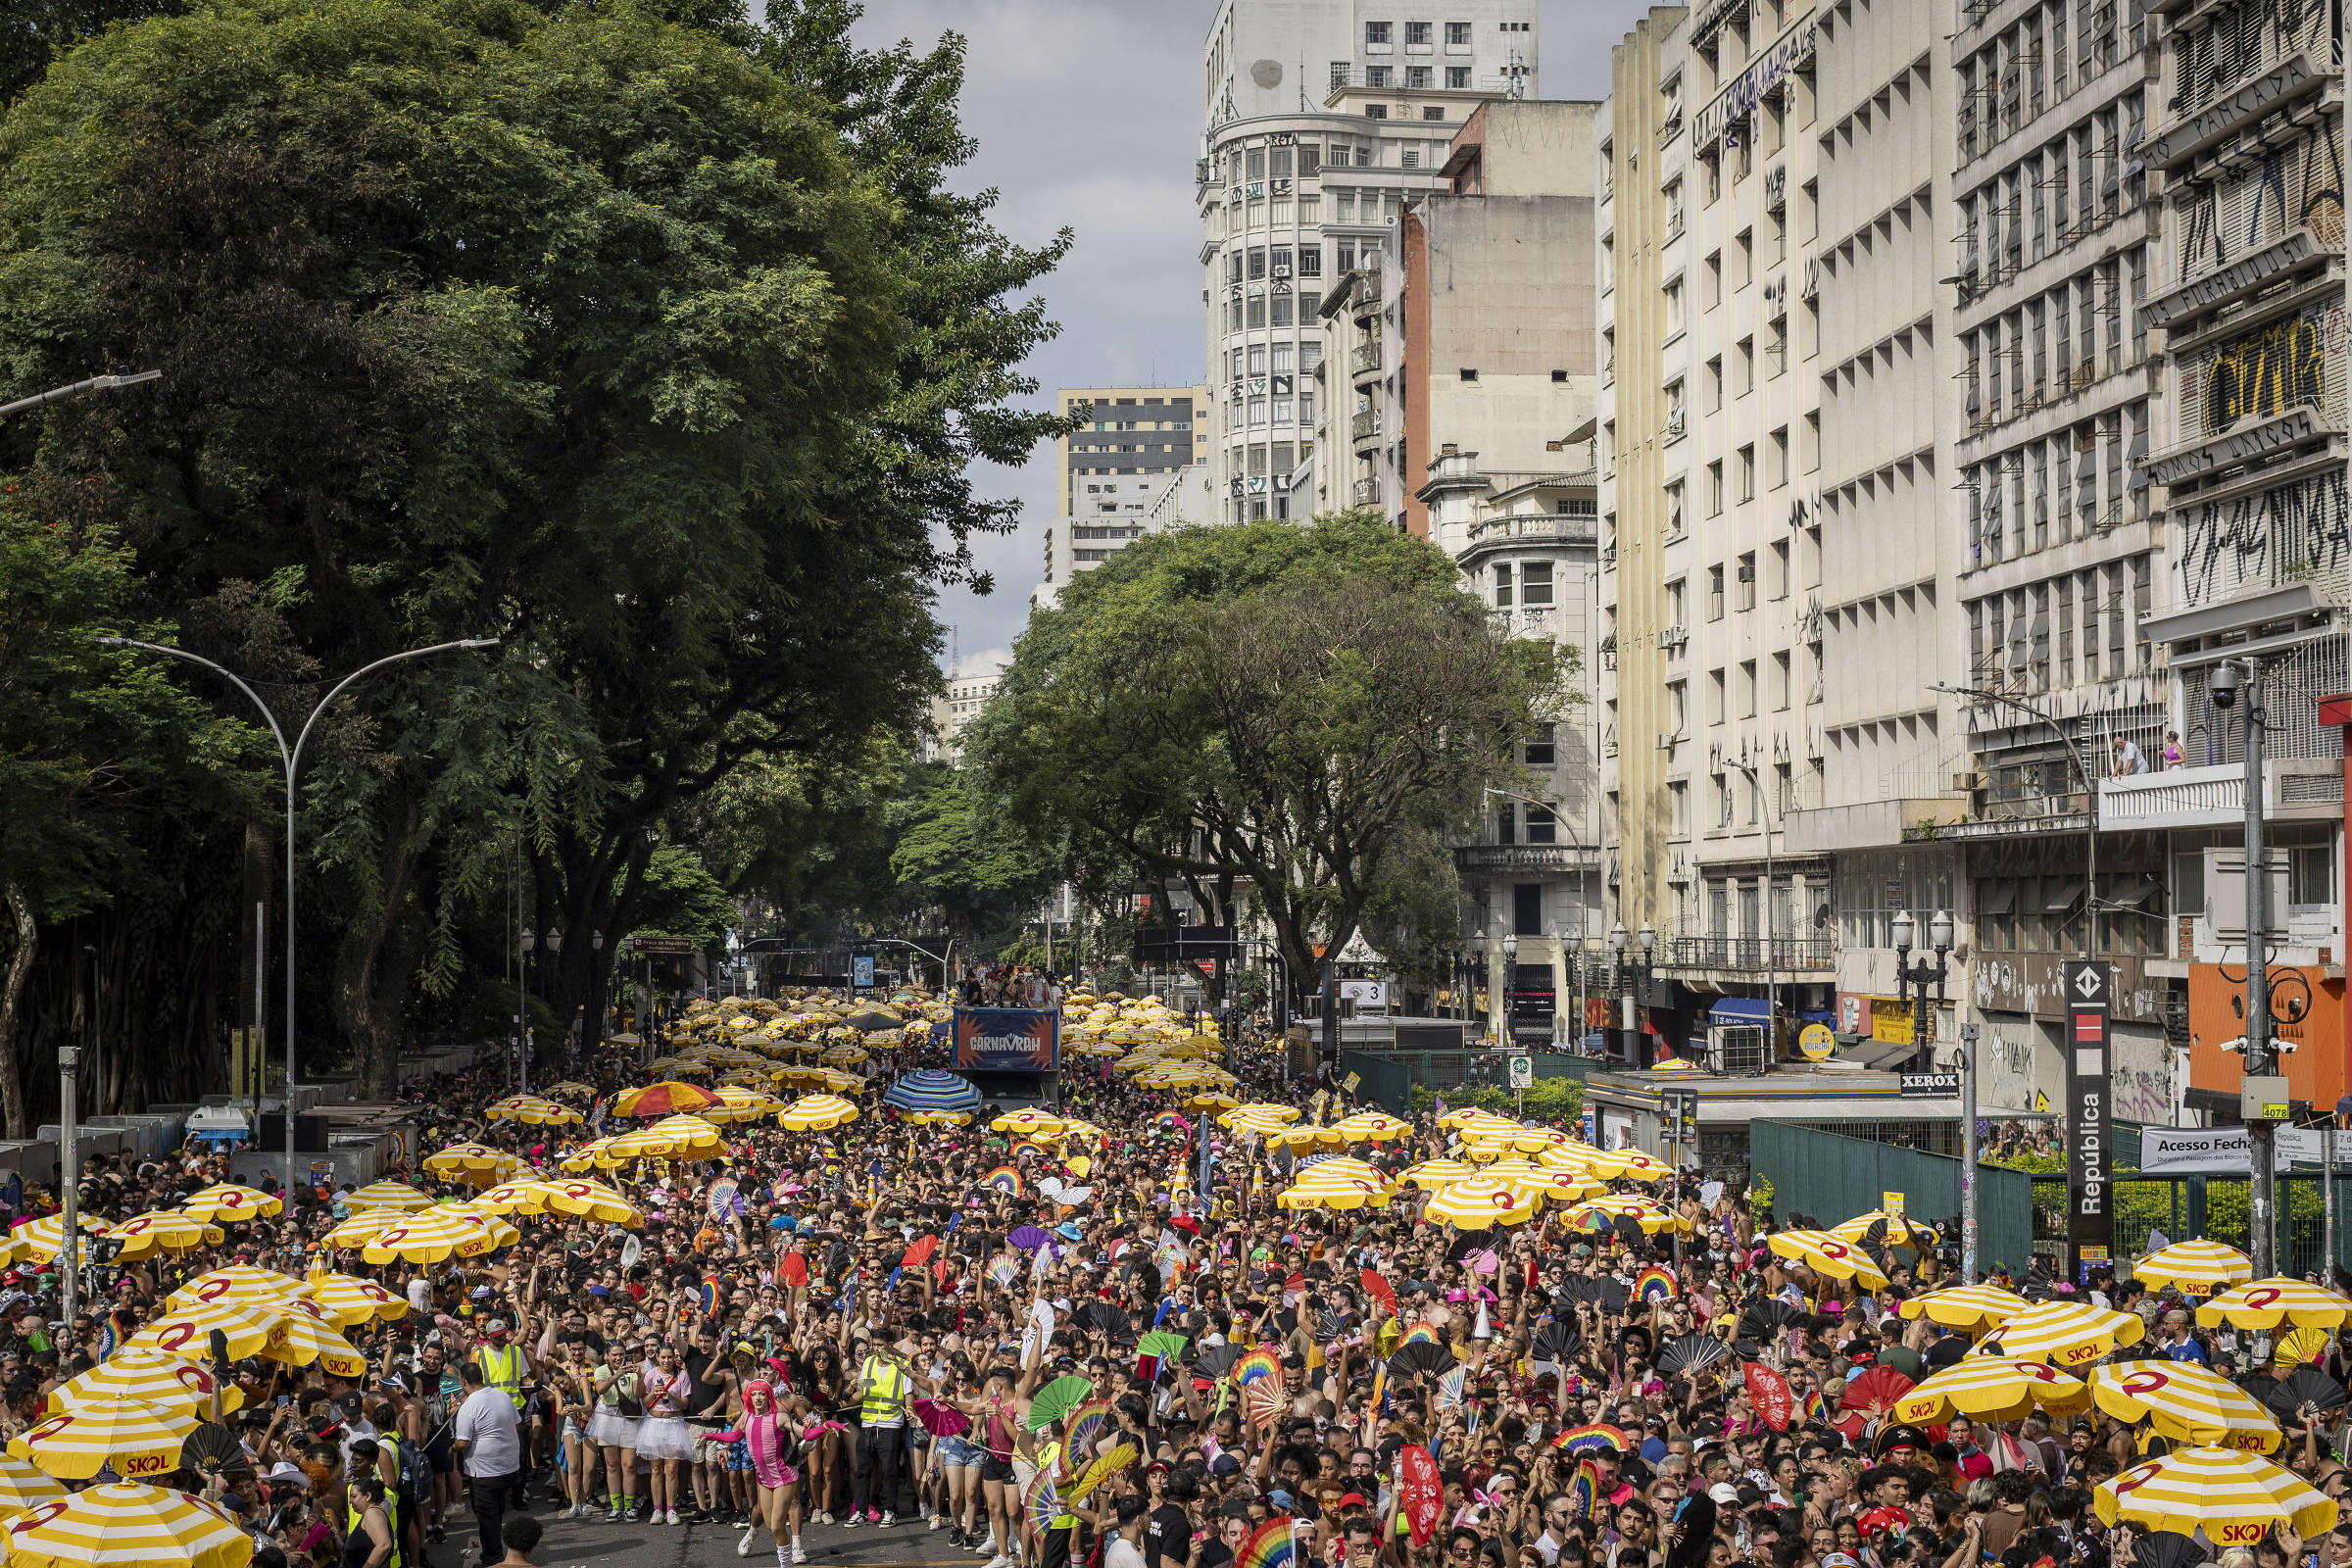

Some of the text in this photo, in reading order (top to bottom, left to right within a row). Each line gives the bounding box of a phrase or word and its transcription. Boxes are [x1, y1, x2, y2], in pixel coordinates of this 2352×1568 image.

[1370, 986, 1379, 1000] 3
[969, 1035, 1041, 1052] CARNAVRAH
[1901, 1074, 1957, 1087] XEROX
[815, 1120, 833, 1129] SKOL
[649, 1145, 666, 1153] SKOL
[2158, 1140, 2210, 1152] Acesso
[2081, 1092, 2101, 1215] República
[1431, 1212, 1445, 1223] SKOL
[463, 1241, 485, 1255] SKOL
[30, 1250, 46, 1262] KOL
[2184, 1283, 2211, 1295] SKO
[272, 1326, 287, 1343] SKOL
[2067, 1343, 2102, 1363] SKOL
[328, 1359, 354, 1374] SKOL
[1908, 1400, 1936, 1419] SKOL
[2237, 1435, 2267, 1451] SKOL
[126, 1454, 170, 1474] SKOL
